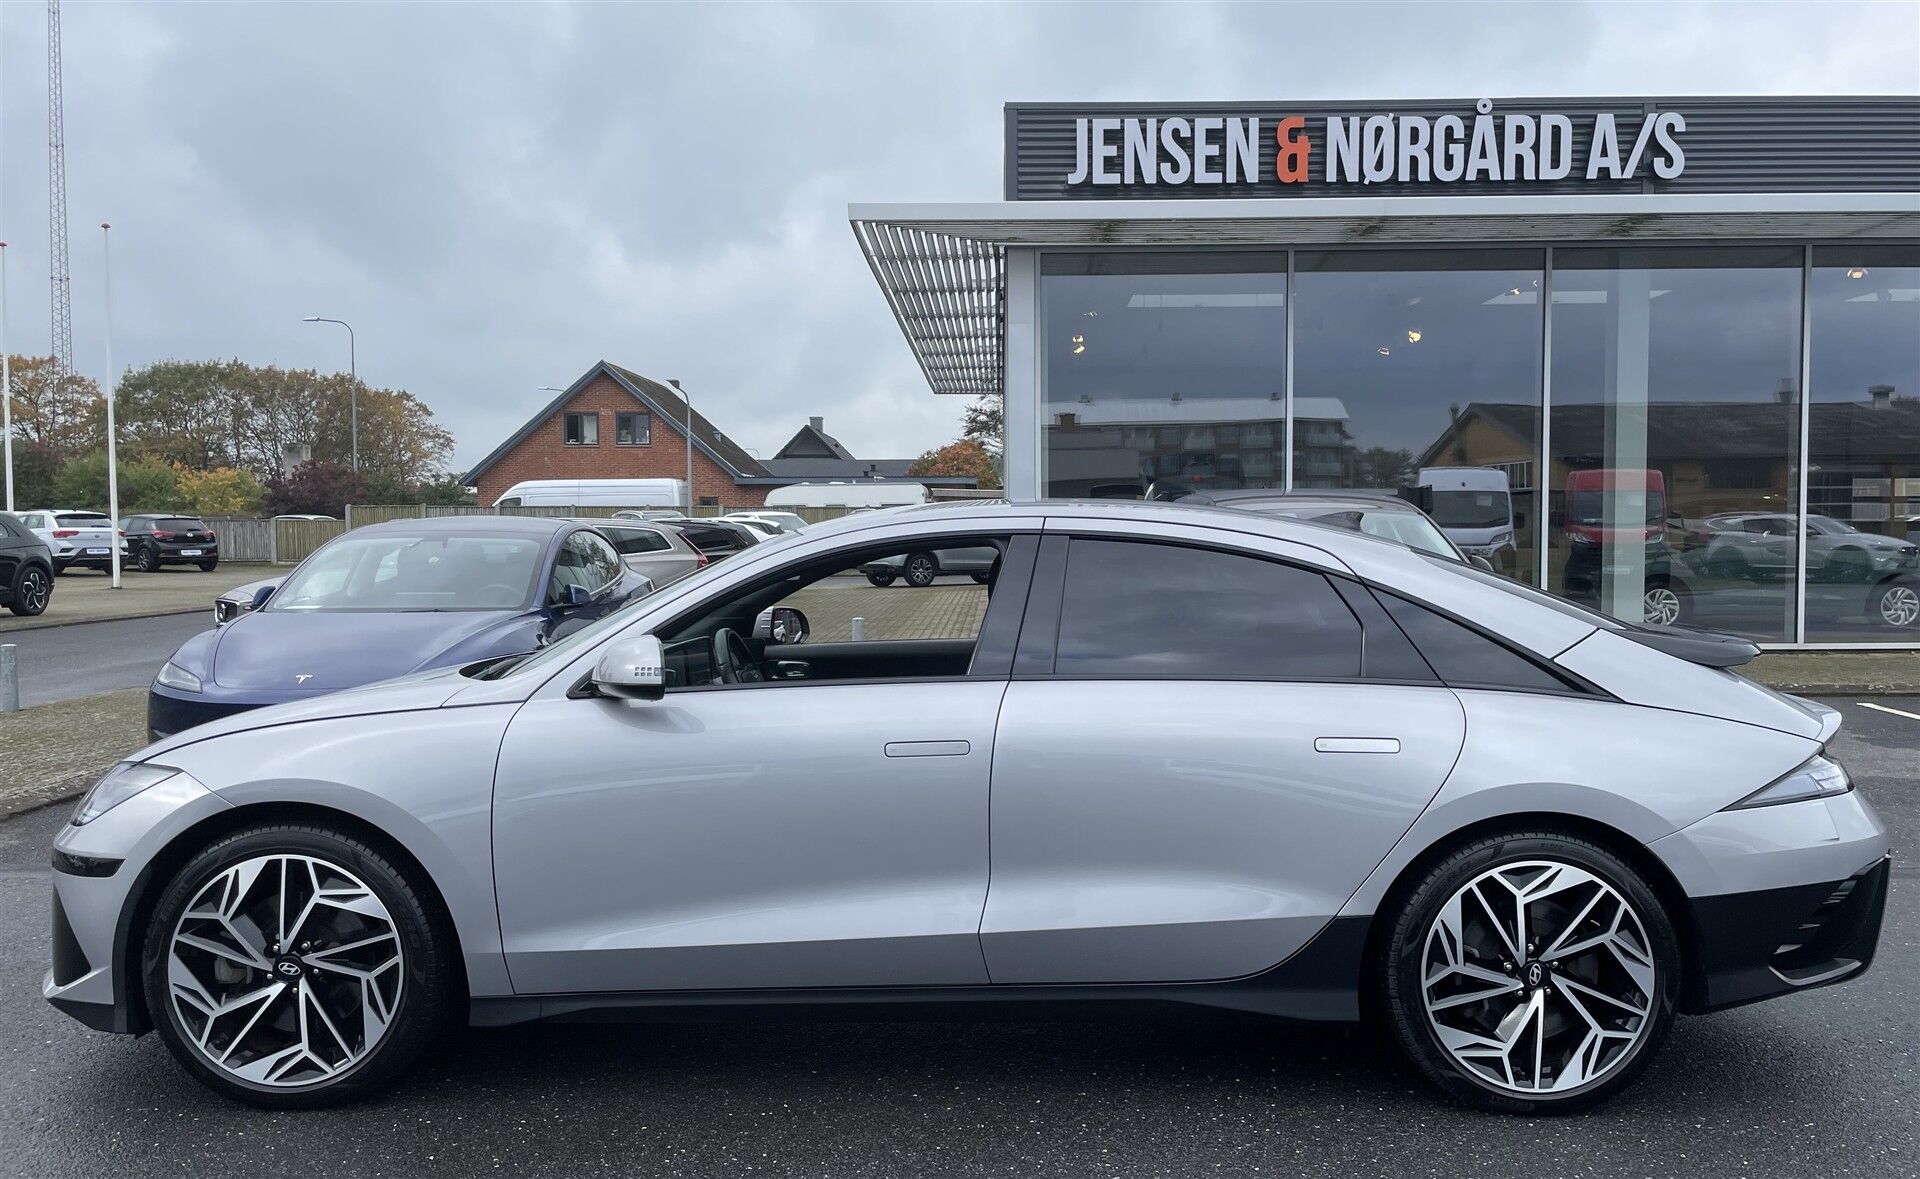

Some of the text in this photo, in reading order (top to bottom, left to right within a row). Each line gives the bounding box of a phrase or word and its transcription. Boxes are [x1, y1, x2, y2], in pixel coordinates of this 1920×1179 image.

[1067, 98, 1686, 186] JENSEN & NØRGÅRD A/S
